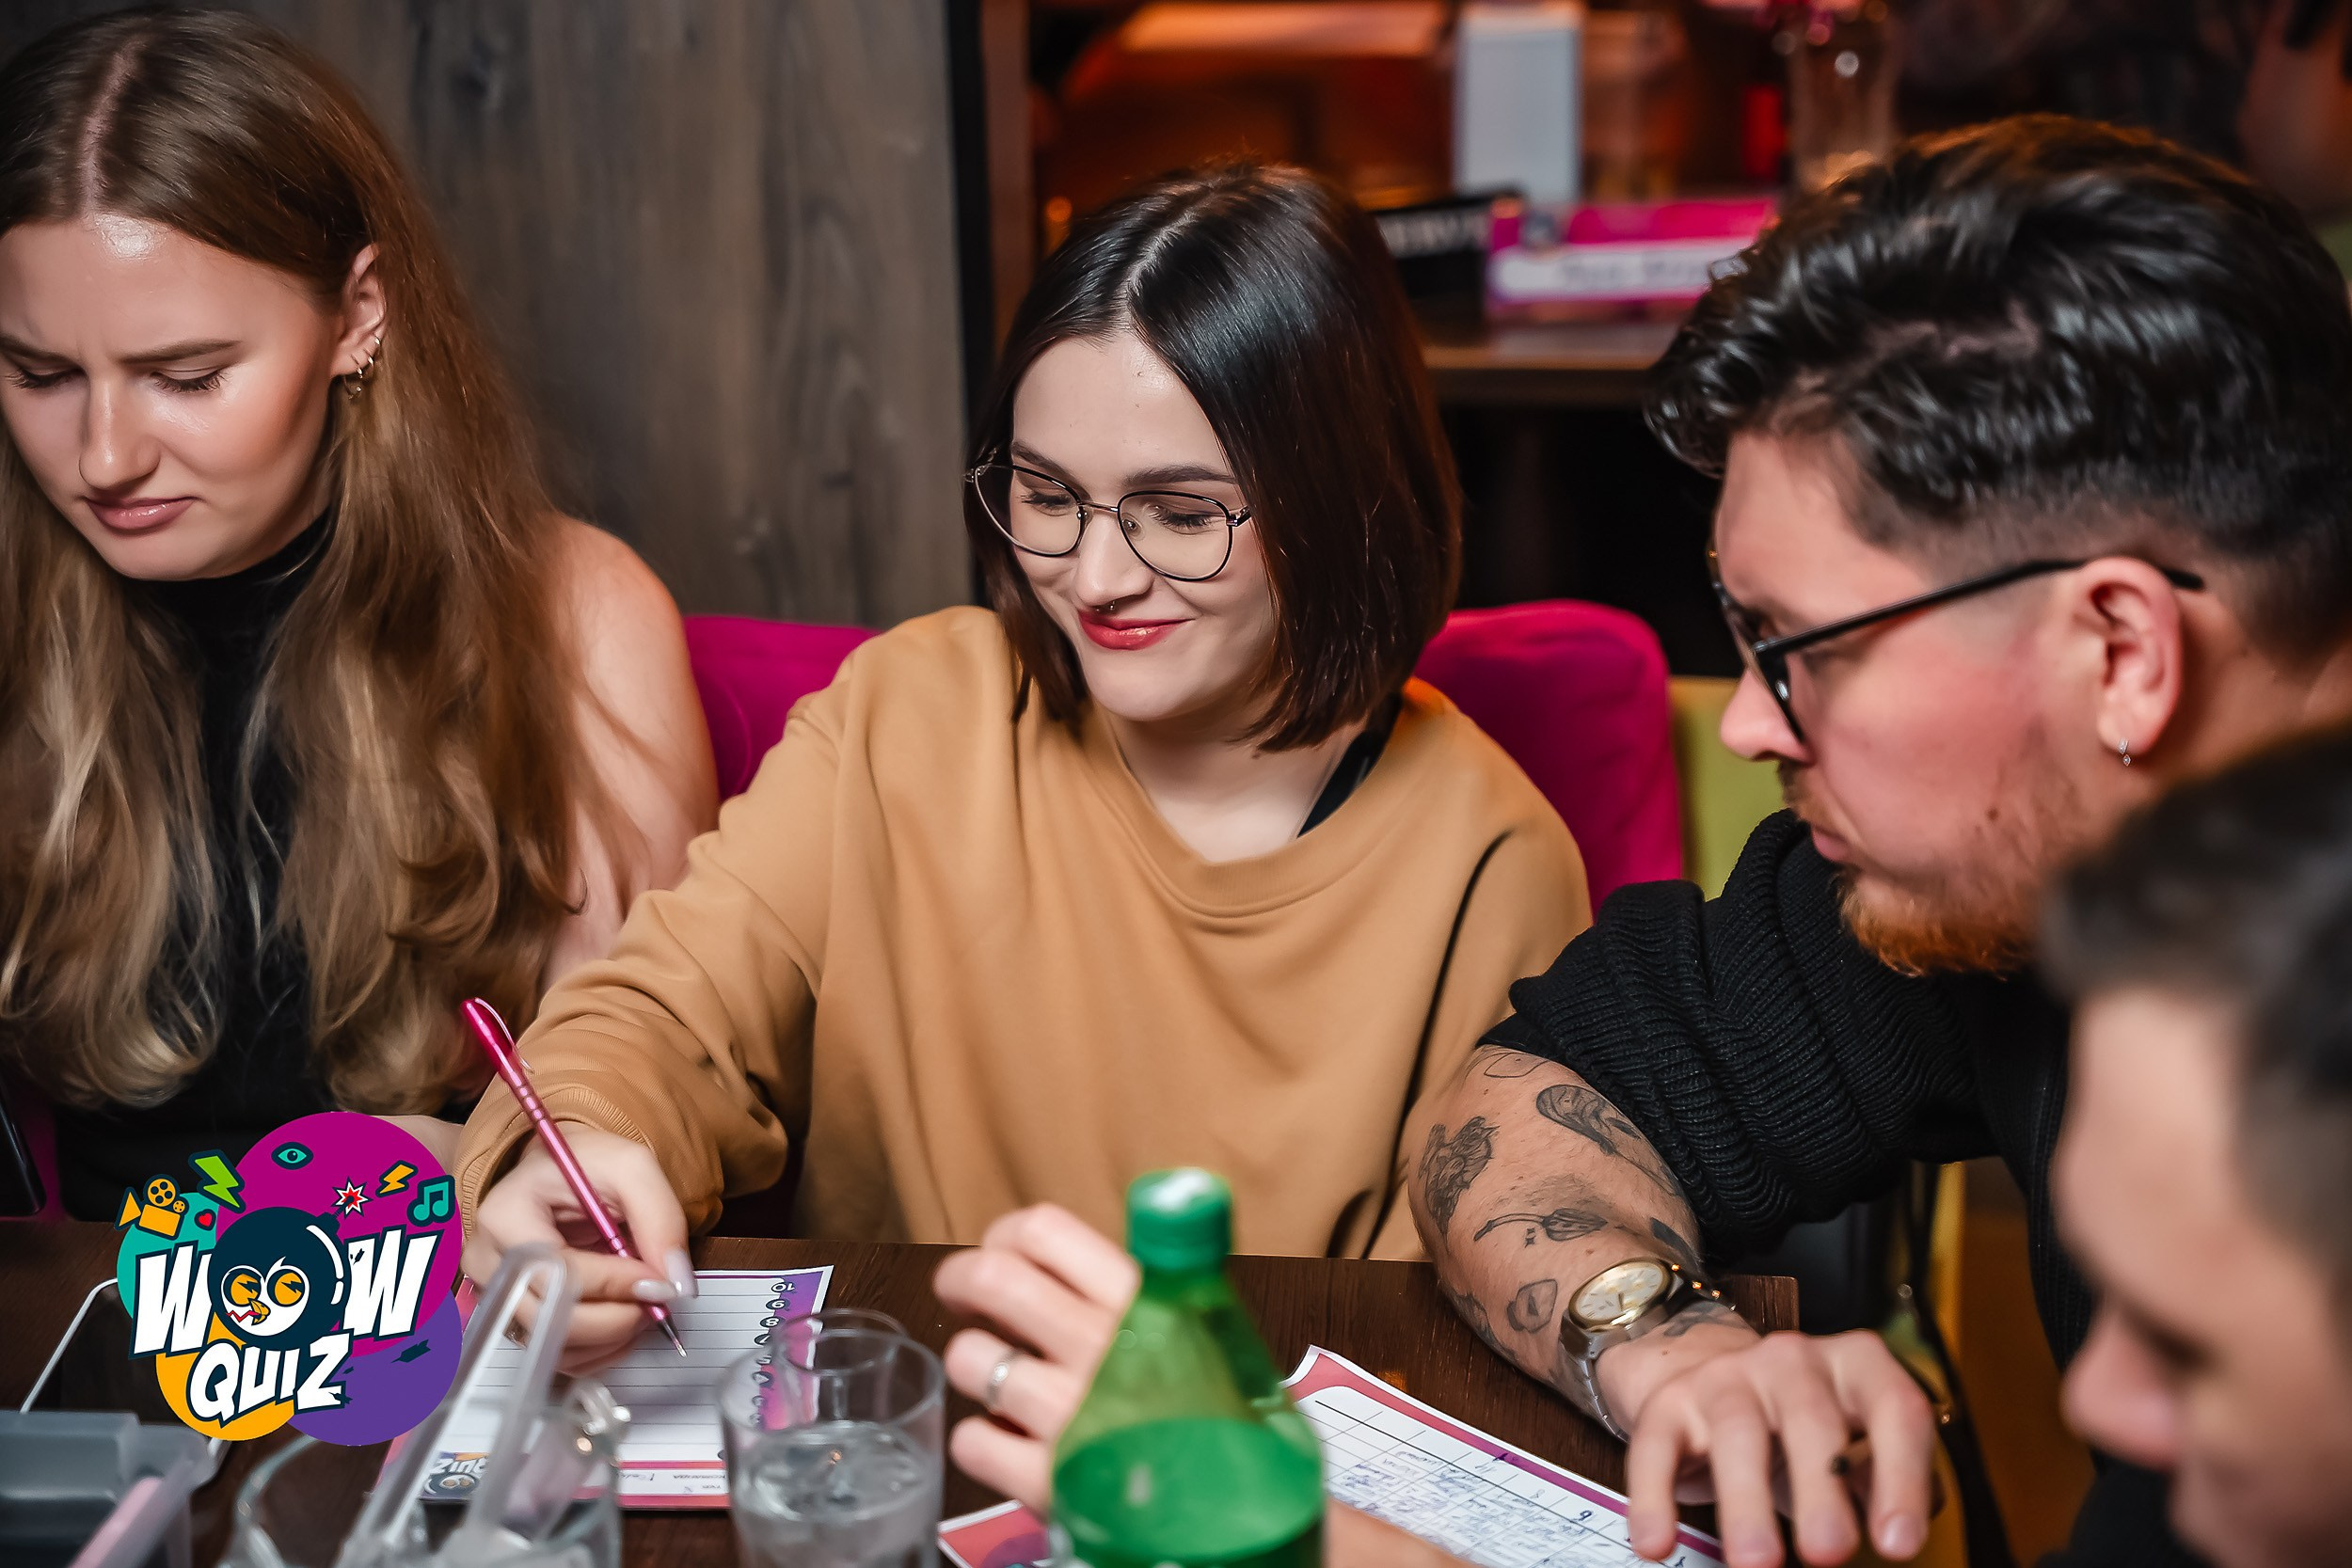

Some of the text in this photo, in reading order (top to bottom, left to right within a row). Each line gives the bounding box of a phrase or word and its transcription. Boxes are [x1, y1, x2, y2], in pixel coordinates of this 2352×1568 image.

[771, 1282, 795, 1291] 10
[771, 1300, 786, 1308] 9
[765, 1318, 780, 1326] 8
